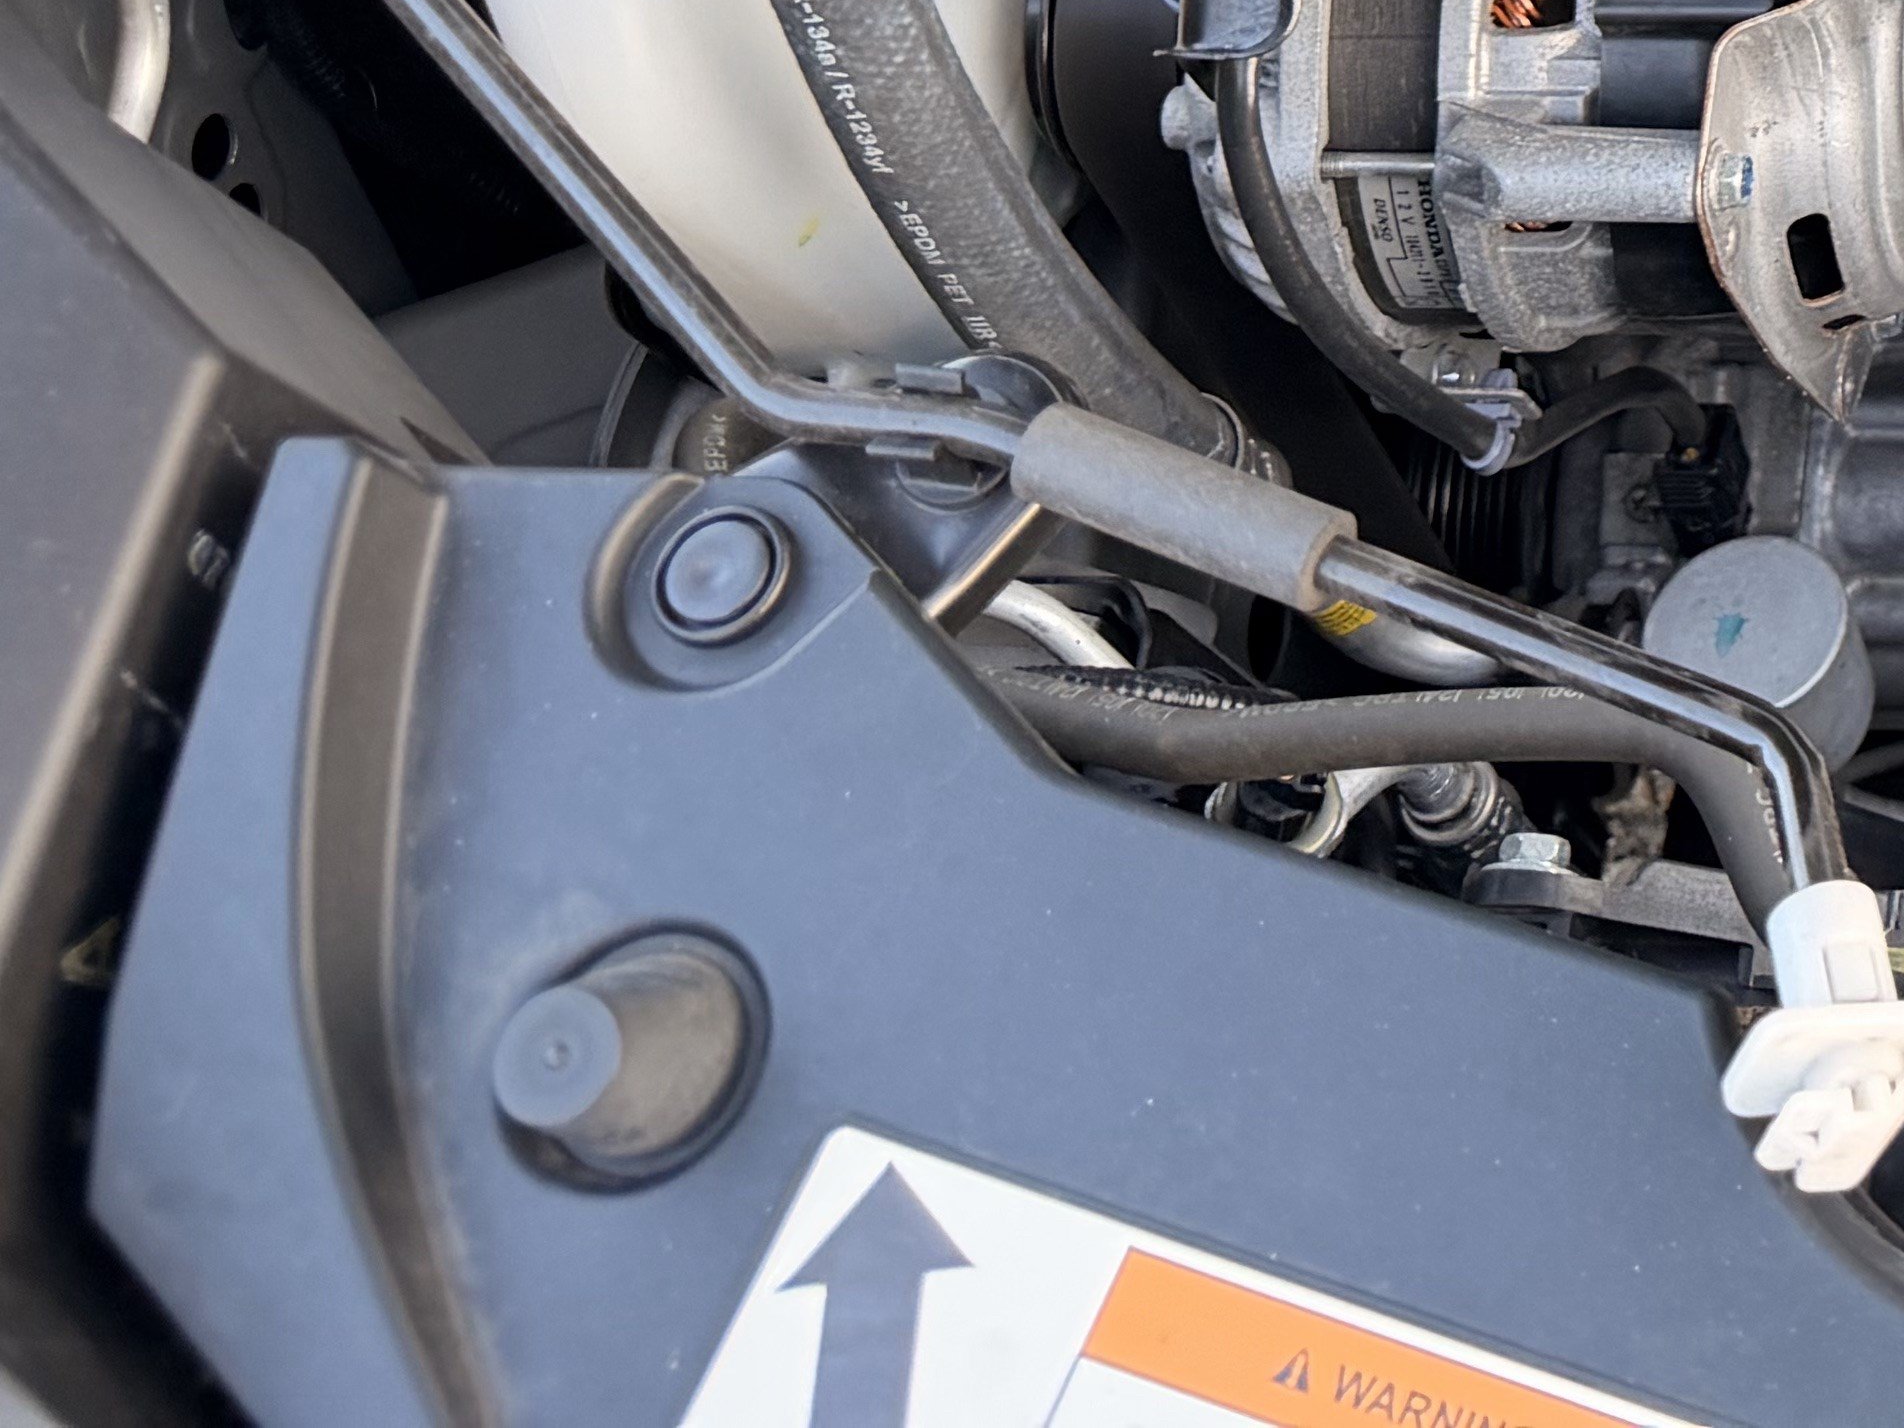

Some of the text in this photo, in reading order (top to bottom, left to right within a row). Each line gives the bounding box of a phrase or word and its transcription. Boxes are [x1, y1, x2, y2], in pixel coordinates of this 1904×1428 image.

[894, 199, 946, 267] >EPDM
[937, 272, 973, 308] PET
[1373, 197, 1395, 243] DENSO
[1417, 175, 1445, 258] HONDA
